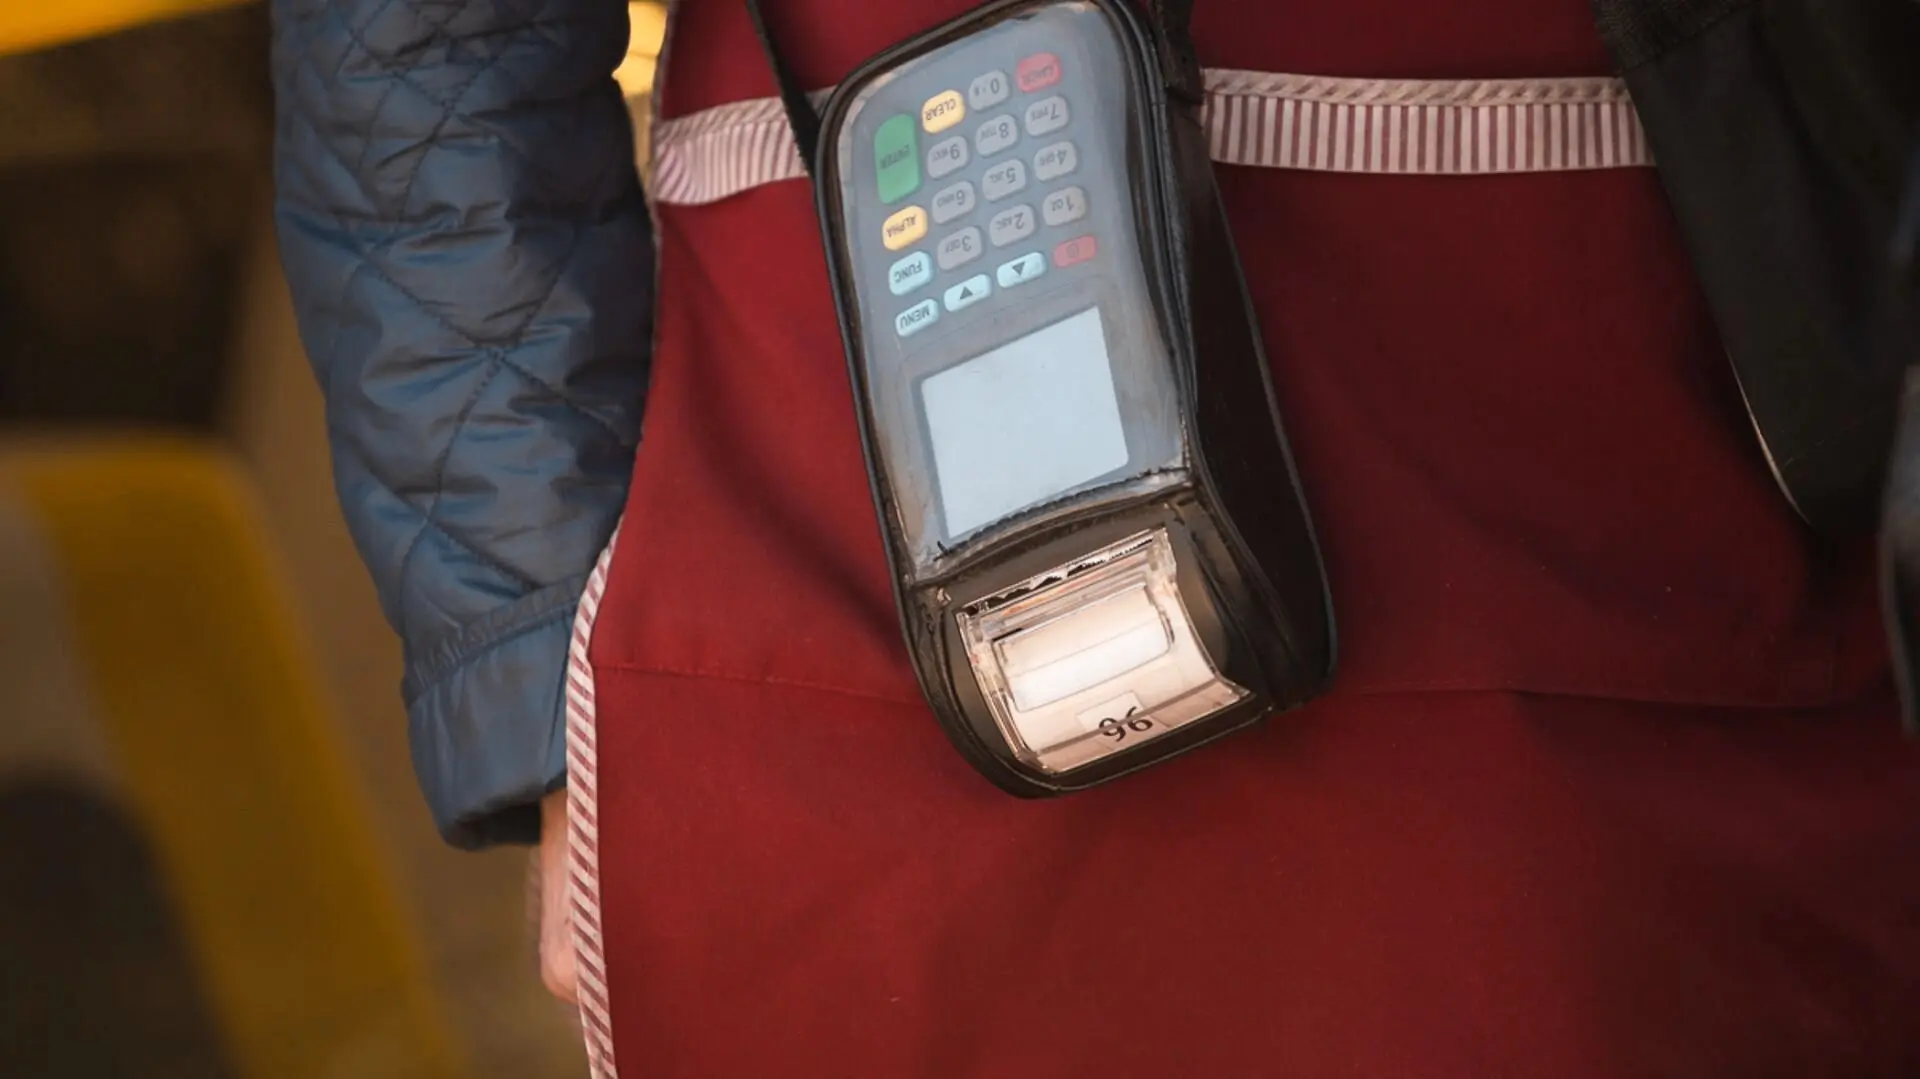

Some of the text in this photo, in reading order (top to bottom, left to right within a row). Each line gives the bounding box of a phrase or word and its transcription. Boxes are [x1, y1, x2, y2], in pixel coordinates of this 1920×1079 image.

[925, 98, 956, 121] CLEAR
[886, 213, 917, 238] ALPHA
[893, 260, 923, 283] FUNC
[899, 304, 930, 328] MENU
[1099, 706, 1153, 742] 96
